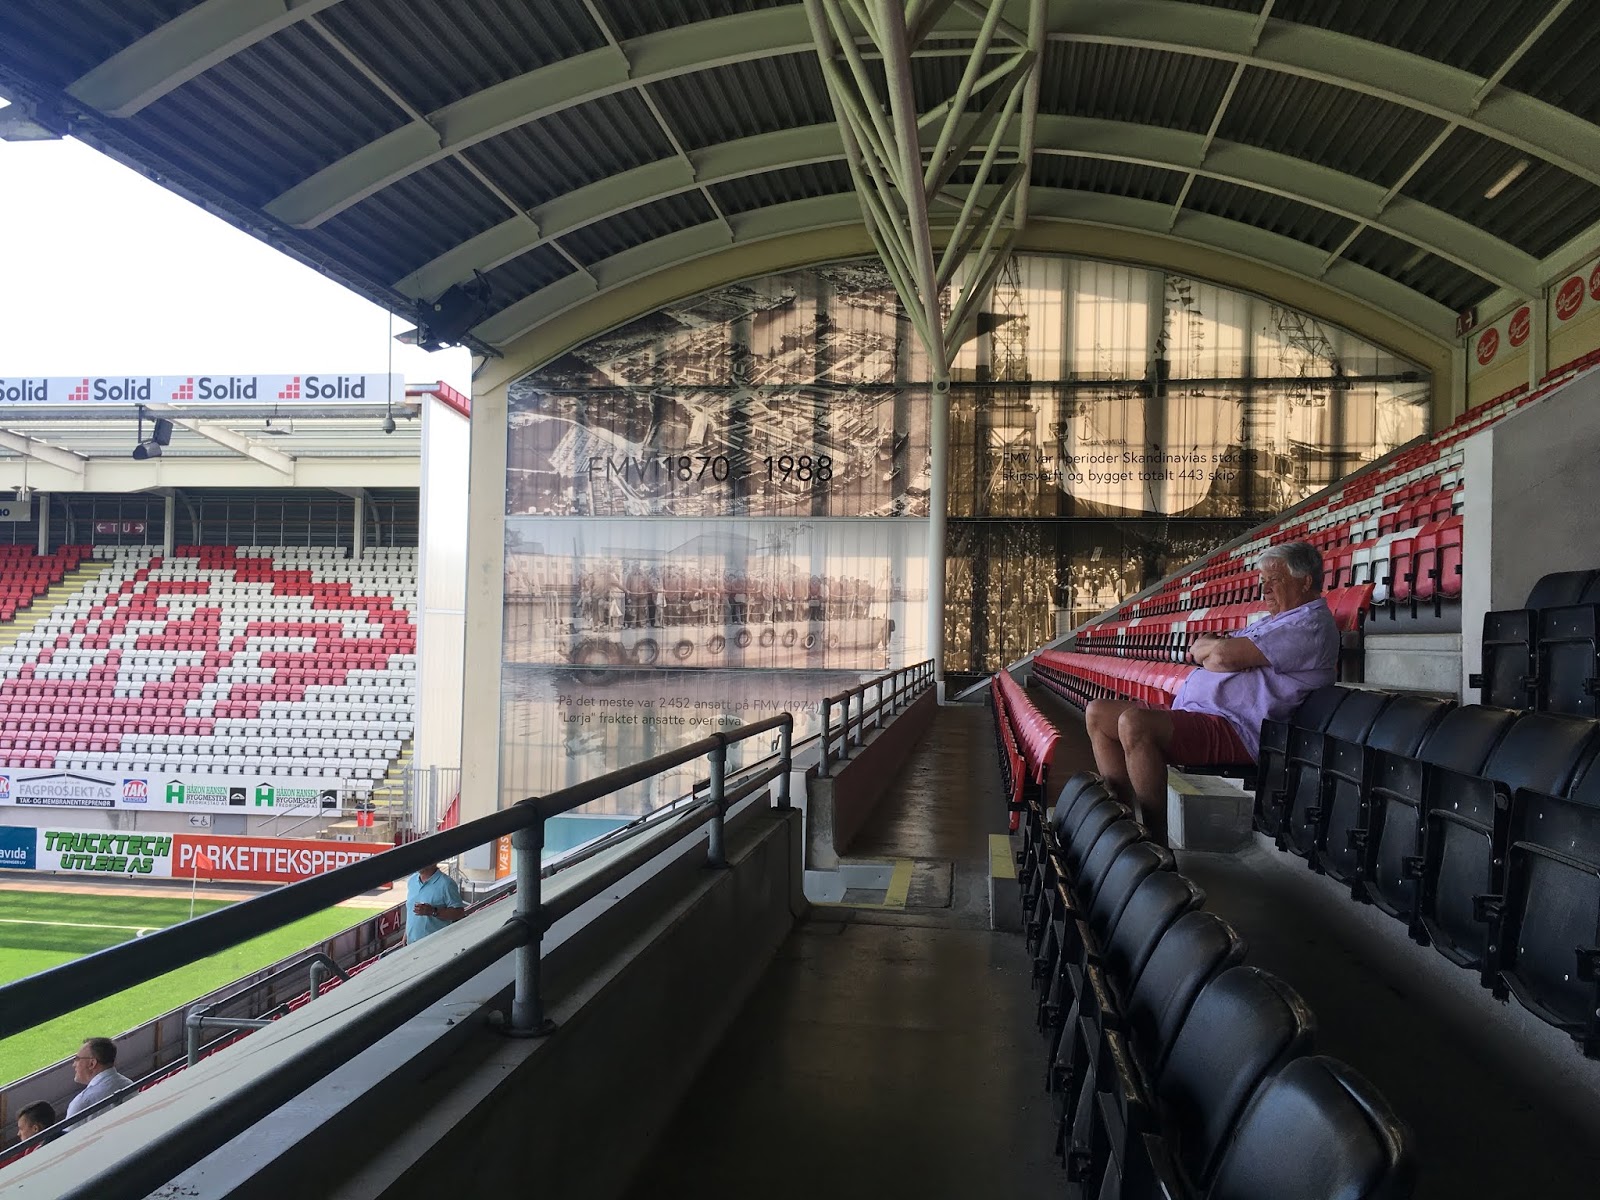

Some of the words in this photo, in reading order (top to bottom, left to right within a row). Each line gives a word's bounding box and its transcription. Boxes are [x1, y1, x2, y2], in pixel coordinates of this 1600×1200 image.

[93, 378, 151, 401] Solid
[198, 377, 257, 400] Solid
[305, 376, 366, 399] Solid
[588, 456, 650, 482] FMV
[662, 456, 730, 482] 1870
[763, 455, 833, 482] 1988
[1003, 453, 1030, 464] FMV
[1035, 455, 1053, 464] var
[1065, 452, 1119, 467] perioder
[1123, 452, 1207, 464] Skandinavias
[1211, 453, 1259, 464] størse
[1068, 472, 1084, 484] og
[1088, 469, 1133, 484] bygget
[1138, 469, 1174, 481] totalt
[1178, 469, 1204, 481] 443
[1208, 469, 1235, 484] skip
[559, 694, 573, 706] På
[576, 694, 596, 706] det
[599, 697, 634, 707] meste
[638, 699, 656, 708] var
[694, 699, 731, 710] ansatt
[735, 699, 749, 713] på
[753, 700, 780, 710] FMV
[599, 712, 638, 724] fraktet
[642, 714, 685, 725] ansatte
[689, 717, 714, 726] over
[717, 715, 741, 726] elva
[20, 785, 94, 797] FAGPROSJEKT
[97, 787, 111, 798] AS
[44, 831, 172, 856] TRUCKTECH
[60, 854, 128, 872] UTLEIE
[128, 857, 154, 874] AS
[180, 844, 374, 875] PARKETTEKSPERT
[393, 911, 400, 930] A
